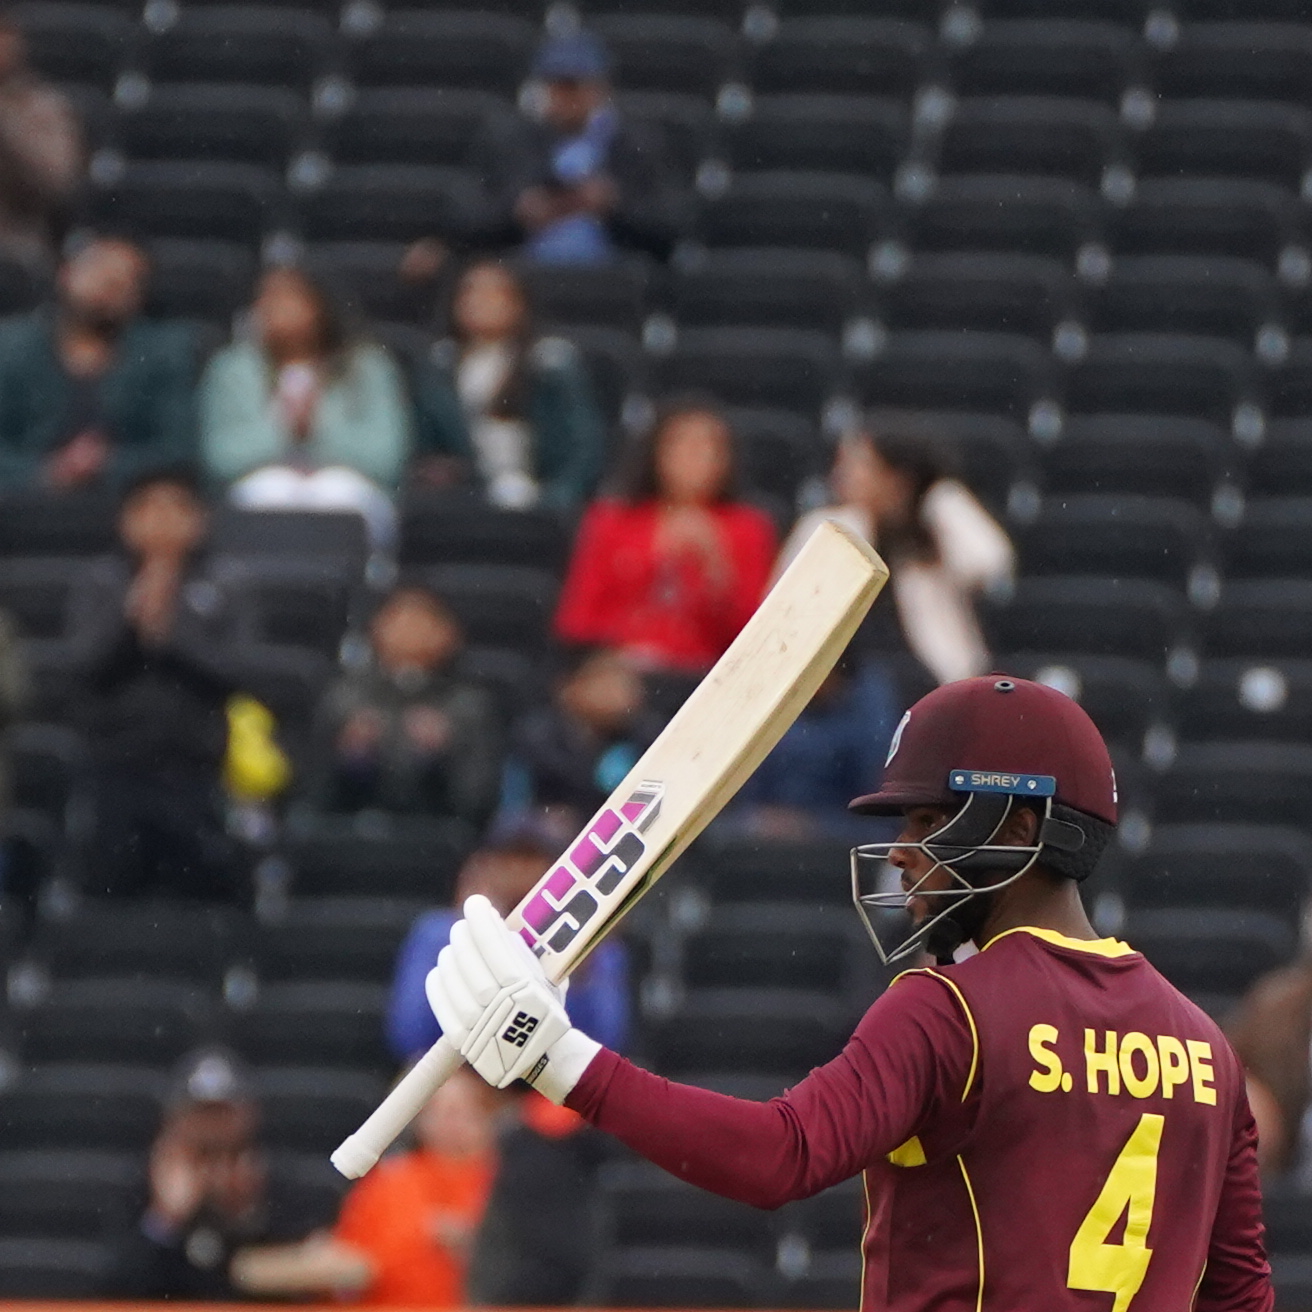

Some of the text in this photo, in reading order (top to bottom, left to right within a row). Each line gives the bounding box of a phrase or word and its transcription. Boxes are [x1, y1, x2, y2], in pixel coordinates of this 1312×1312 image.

[971, 774, 1021, 788] SHREY
[521, 808, 647, 954] SS
[501, 1010, 540, 1049] SS
[1028, 1023, 1217, 1107] S. HOPE
